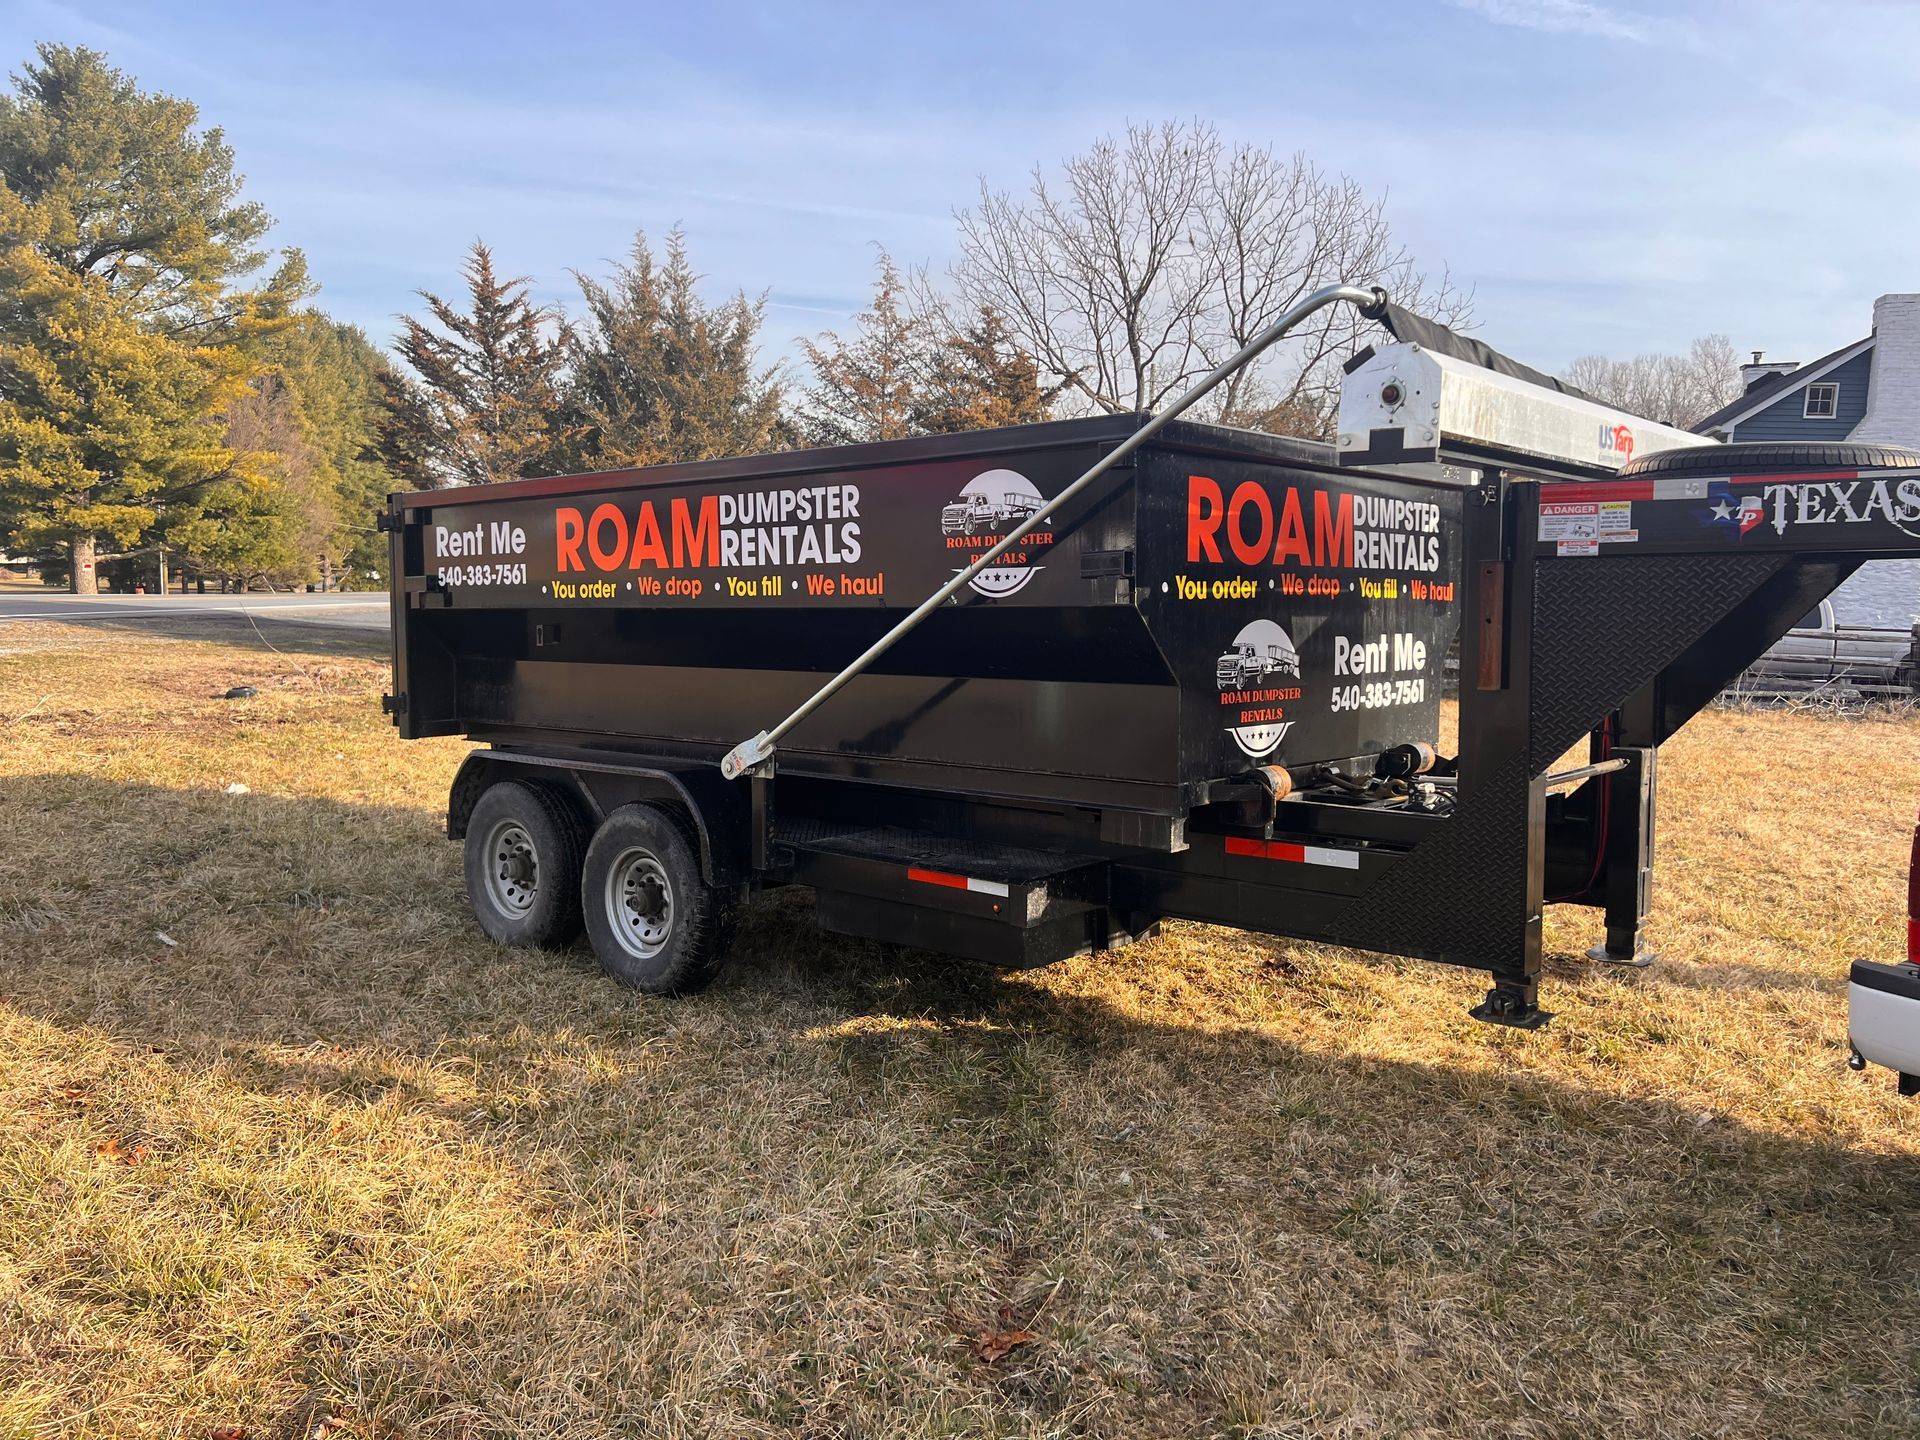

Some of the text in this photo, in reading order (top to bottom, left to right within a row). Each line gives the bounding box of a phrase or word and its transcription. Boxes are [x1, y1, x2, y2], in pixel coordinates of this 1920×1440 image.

[719, 484, 861, 526] DUMPSTER
[1187, 476, 1354, 568] ROAM
[1353, 495, 1440, 534] DUMPSTER
[1554, 505, 1595, 514] DANGER
[1763, 480, 1920, 538] TEXAS
[436, 521, 527, 558] Rent Me
[556, 496, 720, 572] ROAM
[720, 522, 862, 567] RENTALS
[946, 536, 982, 549] ROAM
[1353, 531, 1440, 572] RENTALS
[438, 563, 527, 587] 540-383-7561
[552, 572, 884, 599] You order We drop You fill We haul
[1175, 573, 1454, 602] You order We drop You fill We haul
[1334, 632, 1427, 676] Rent Me
[1221, 687, 1301, 705] ROAM DUMPSTER
[1331, 679, 1425, 713] 540-383-7561
[1241, 707, 1283, 723] RENTALS
